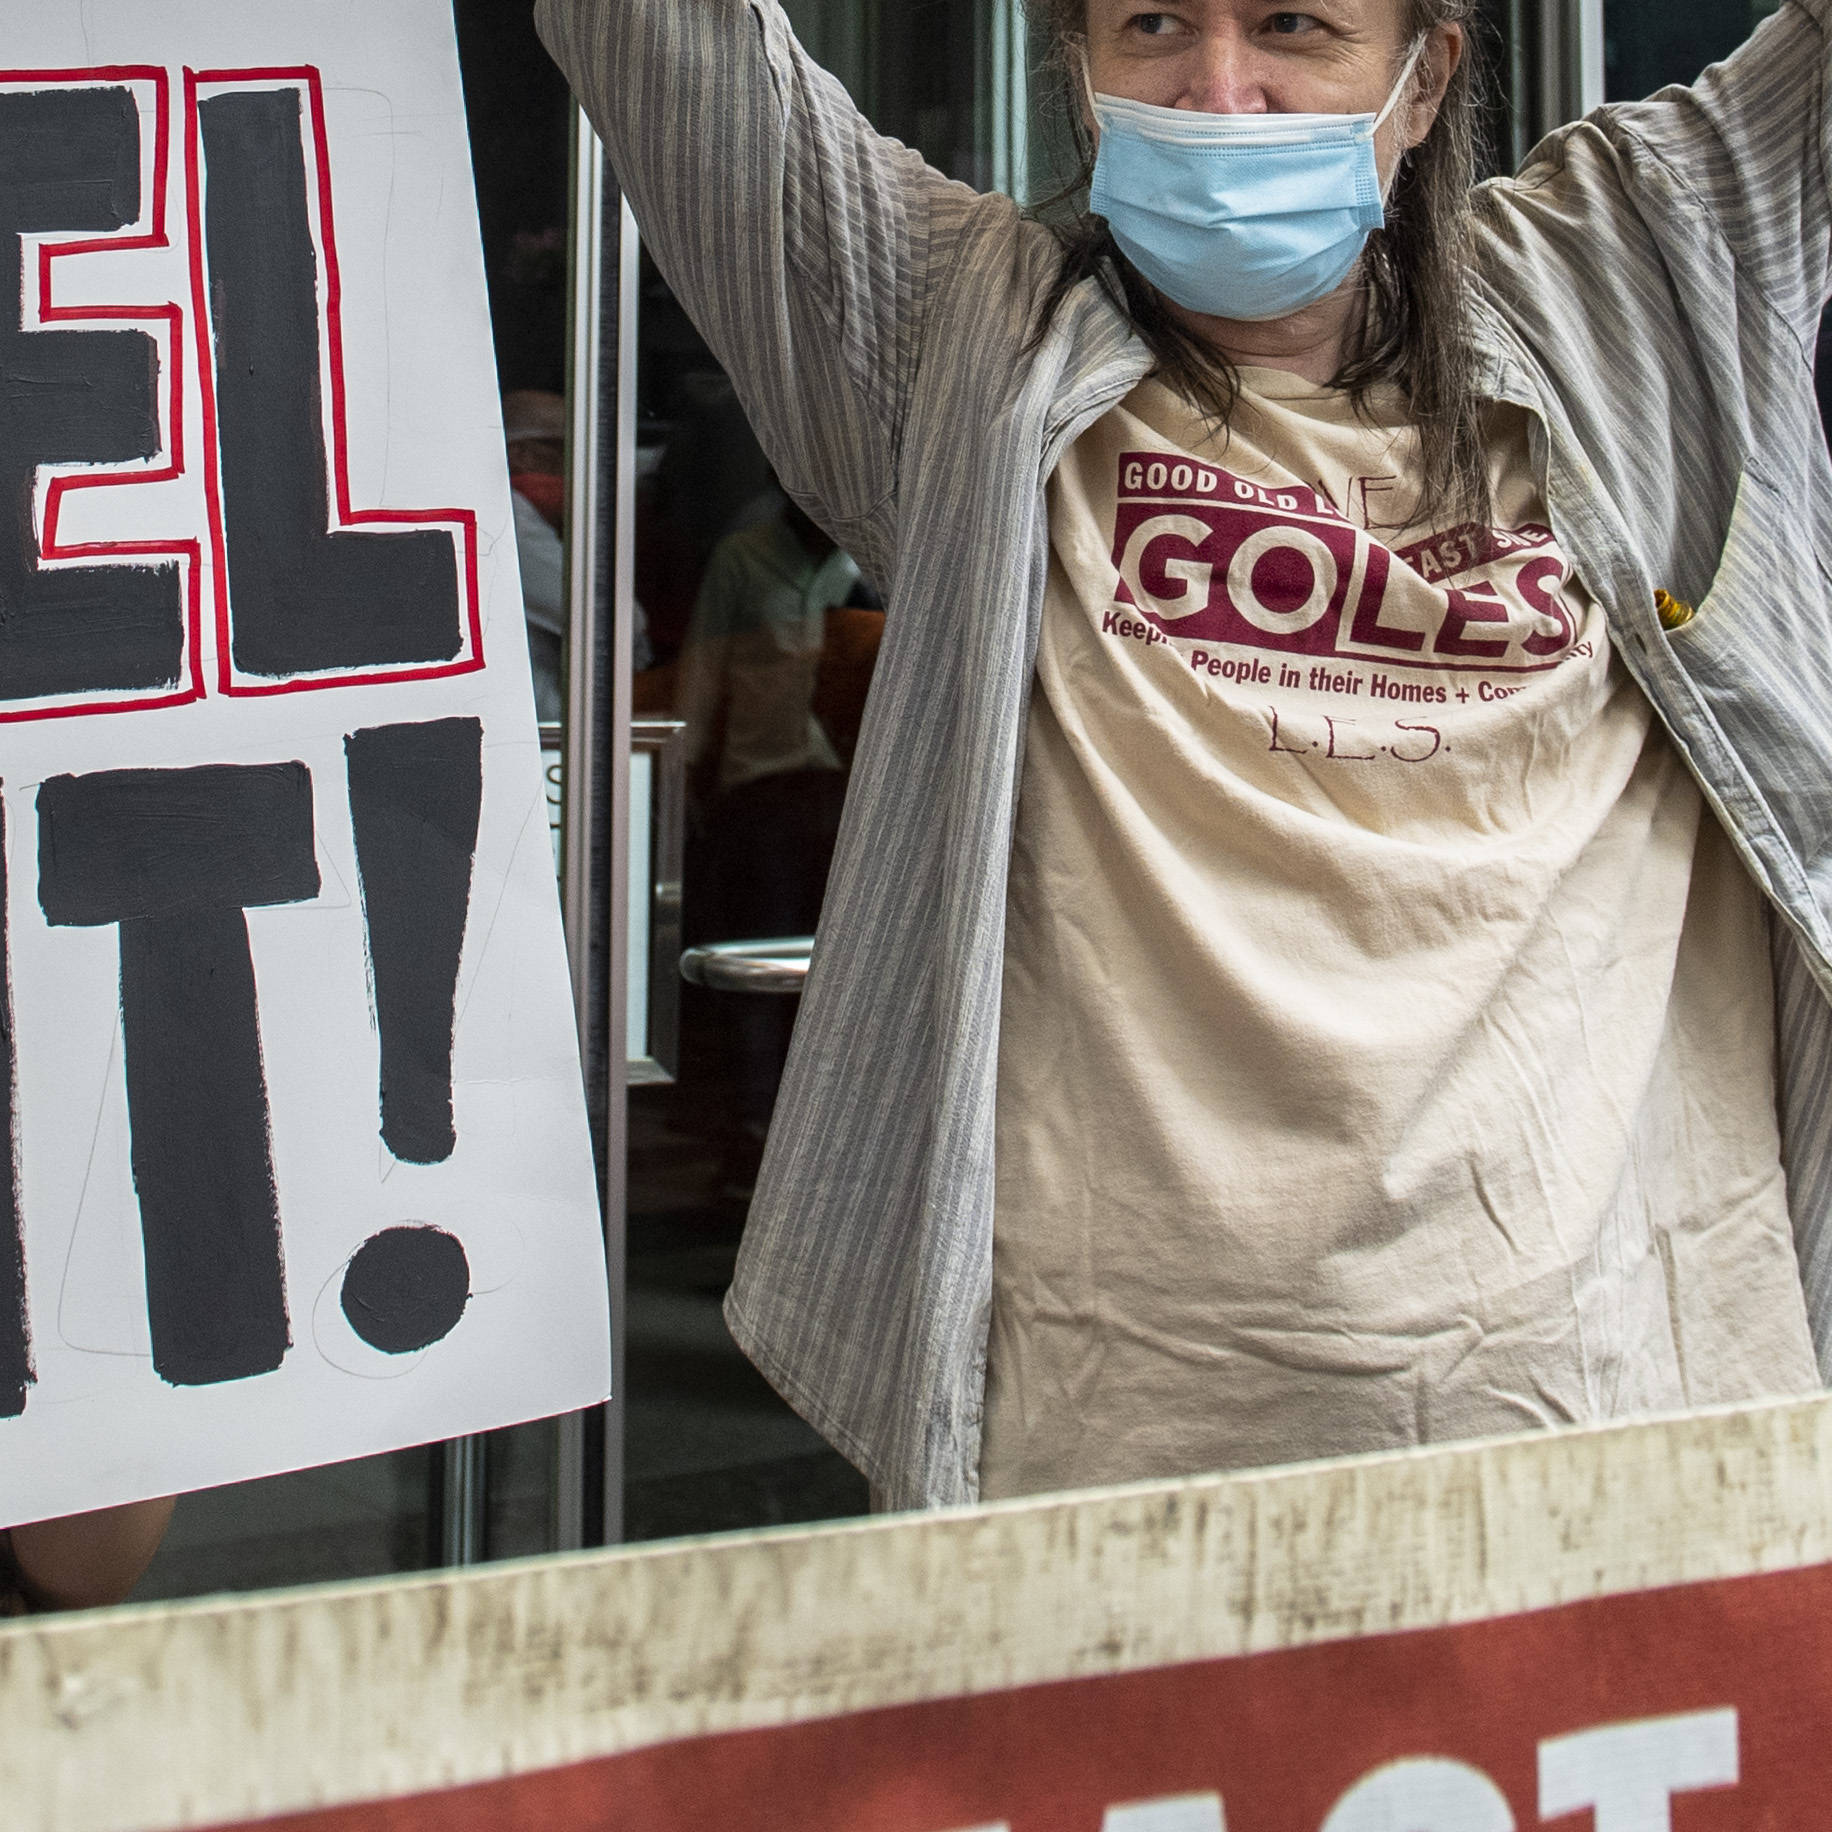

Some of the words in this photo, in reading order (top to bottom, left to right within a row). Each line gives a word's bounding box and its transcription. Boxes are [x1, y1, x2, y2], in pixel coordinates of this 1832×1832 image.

[1123, 461, 1217, 493] GOOD
[1233, 480, 1298, 511] OLD
[1119, 514, 1571, 659] GOLES
[1102, 611, 1168, 645] Keep
[1191, 650, 1271, 685] People
[1279, 663, 1300, 688] in
[1309, 667, 1362, 696] their
[1371, 674, 1447, 703] Homes
